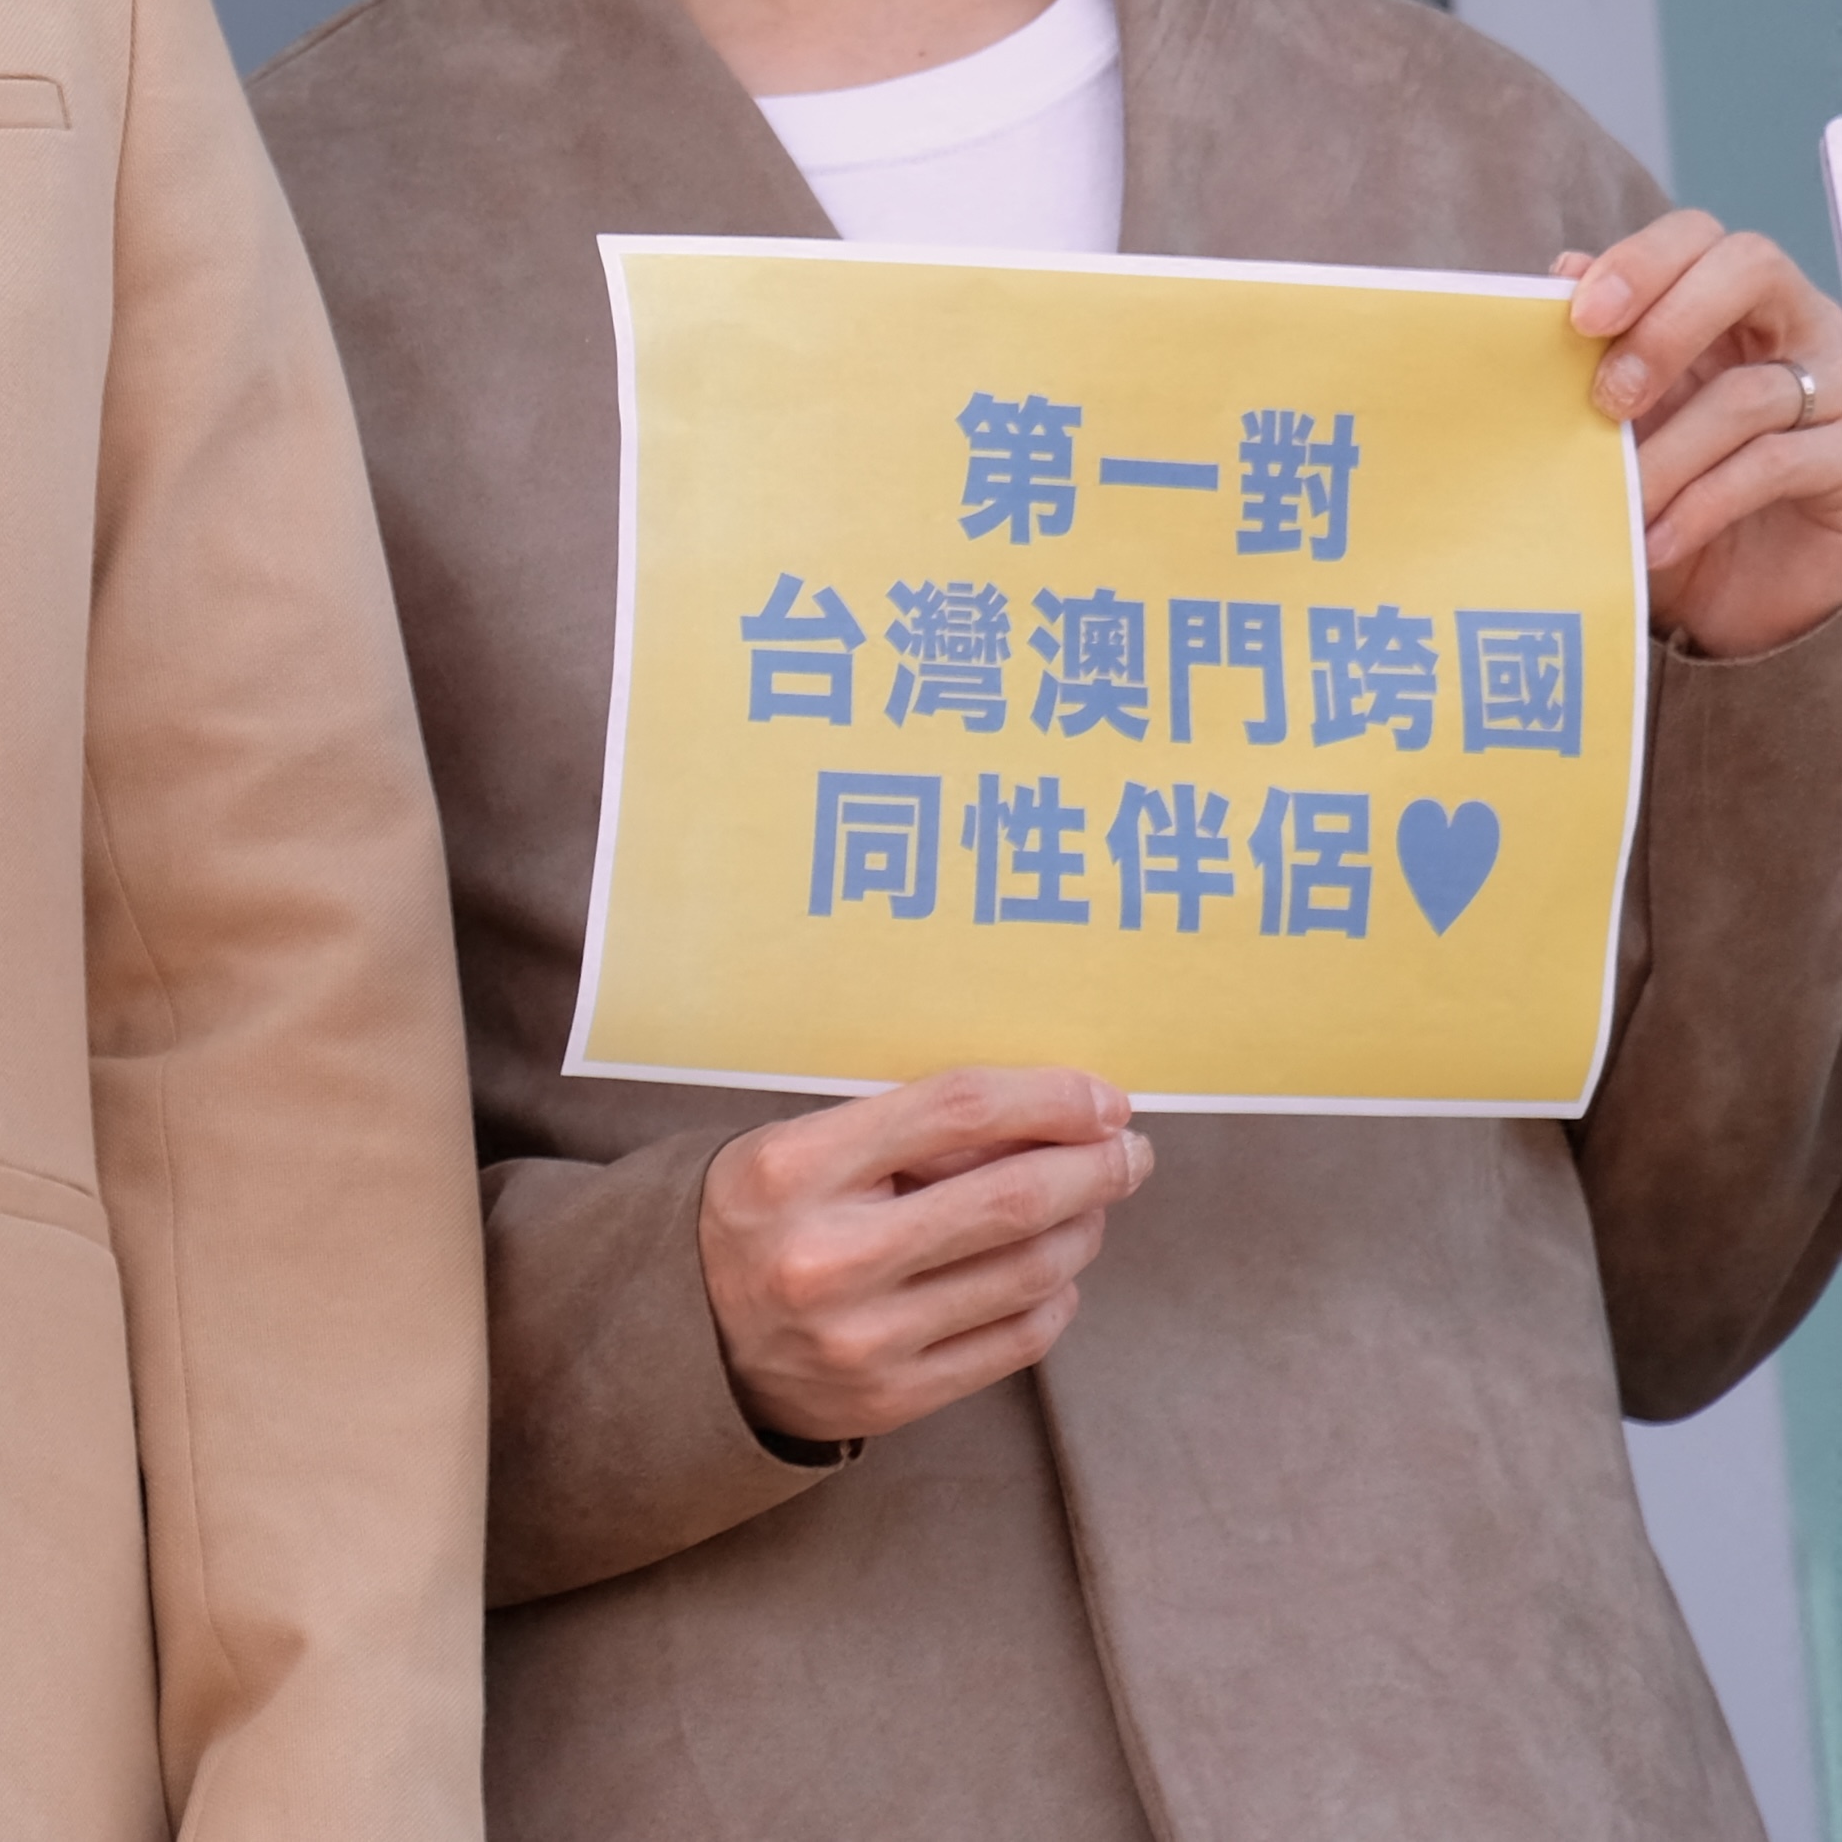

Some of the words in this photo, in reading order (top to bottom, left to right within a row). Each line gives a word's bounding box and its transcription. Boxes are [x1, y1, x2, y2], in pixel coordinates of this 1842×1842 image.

[954, 391, 1361, 562] 第一對
[739, 572, 1584, 757] 台灣澳門跨國
[806, 770, 1373, 939] 同性伴侶
